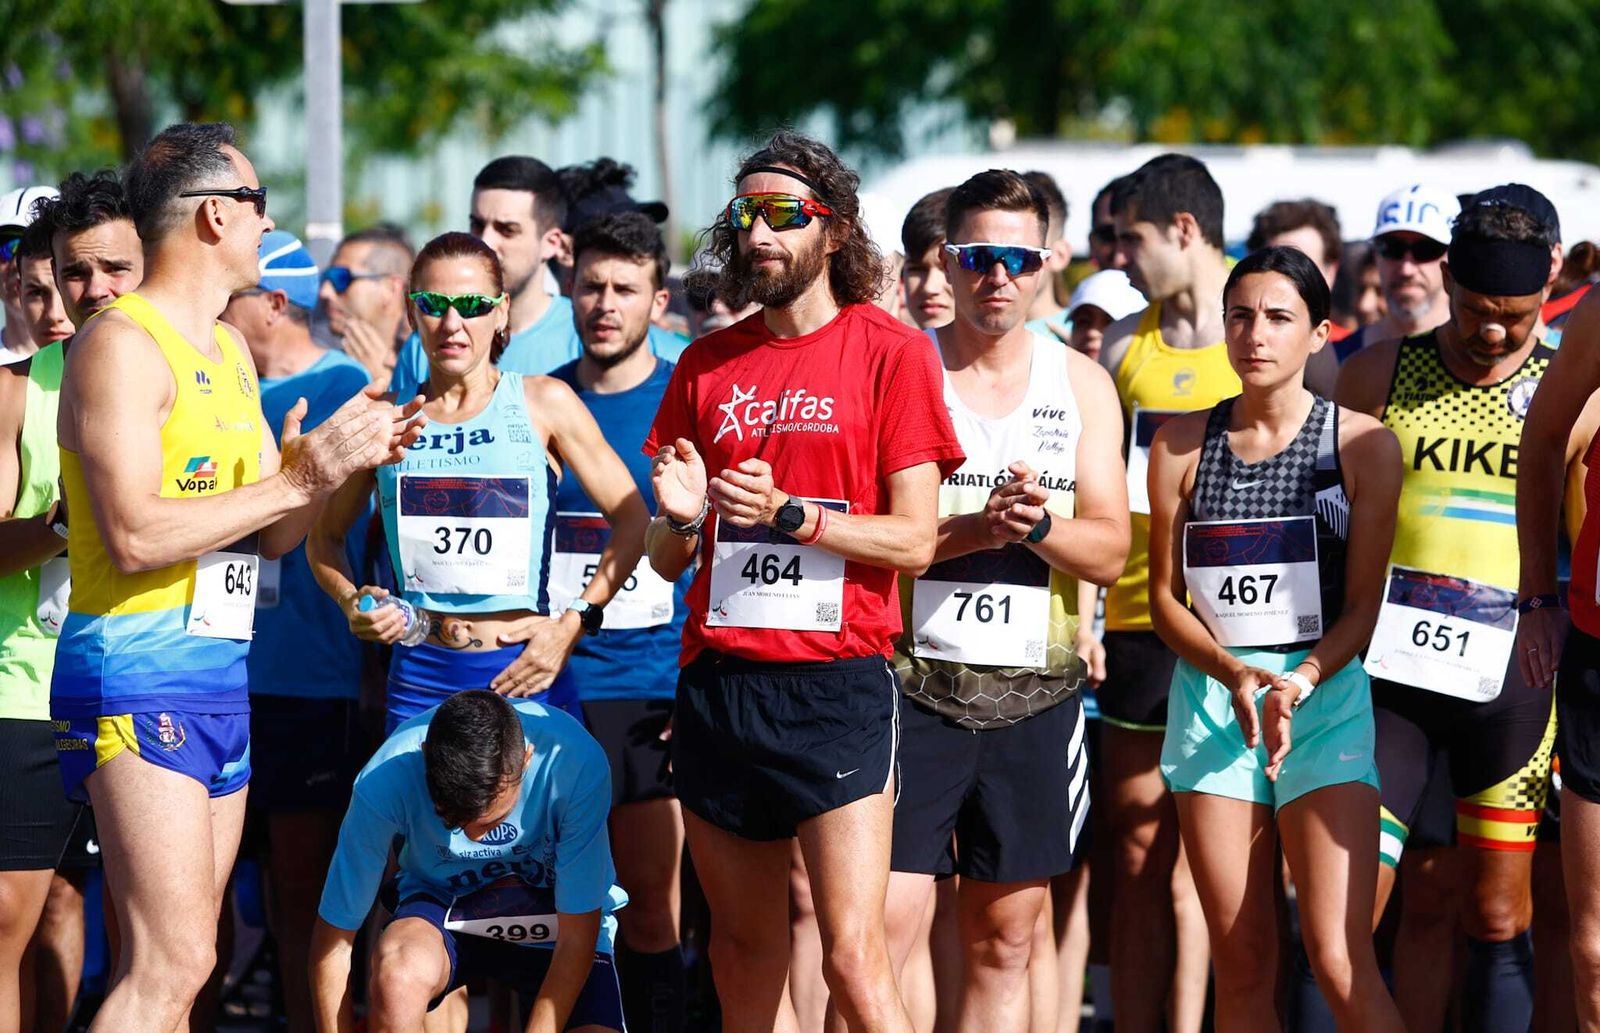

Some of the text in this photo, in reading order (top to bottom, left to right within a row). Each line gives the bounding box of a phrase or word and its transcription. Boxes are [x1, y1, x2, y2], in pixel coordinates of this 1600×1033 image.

[407, 427, 495, 454] erja
[1414, 437, 1519, 478] KIKE
[941, 469, 1077, 493] RIATLÓ ÁLAGA
[433, 527, 493, 555] 370
[225, 563, 252, 596] 643
[582, 564, 638, 592] 56
[741, 553, 803, 586] 464
[1218, 574, 1279, 606] 467
[953, 592, 1012, 624] 761
[1412, 620, 1471, 657] 651
[485, 923, 550, 942] 399
